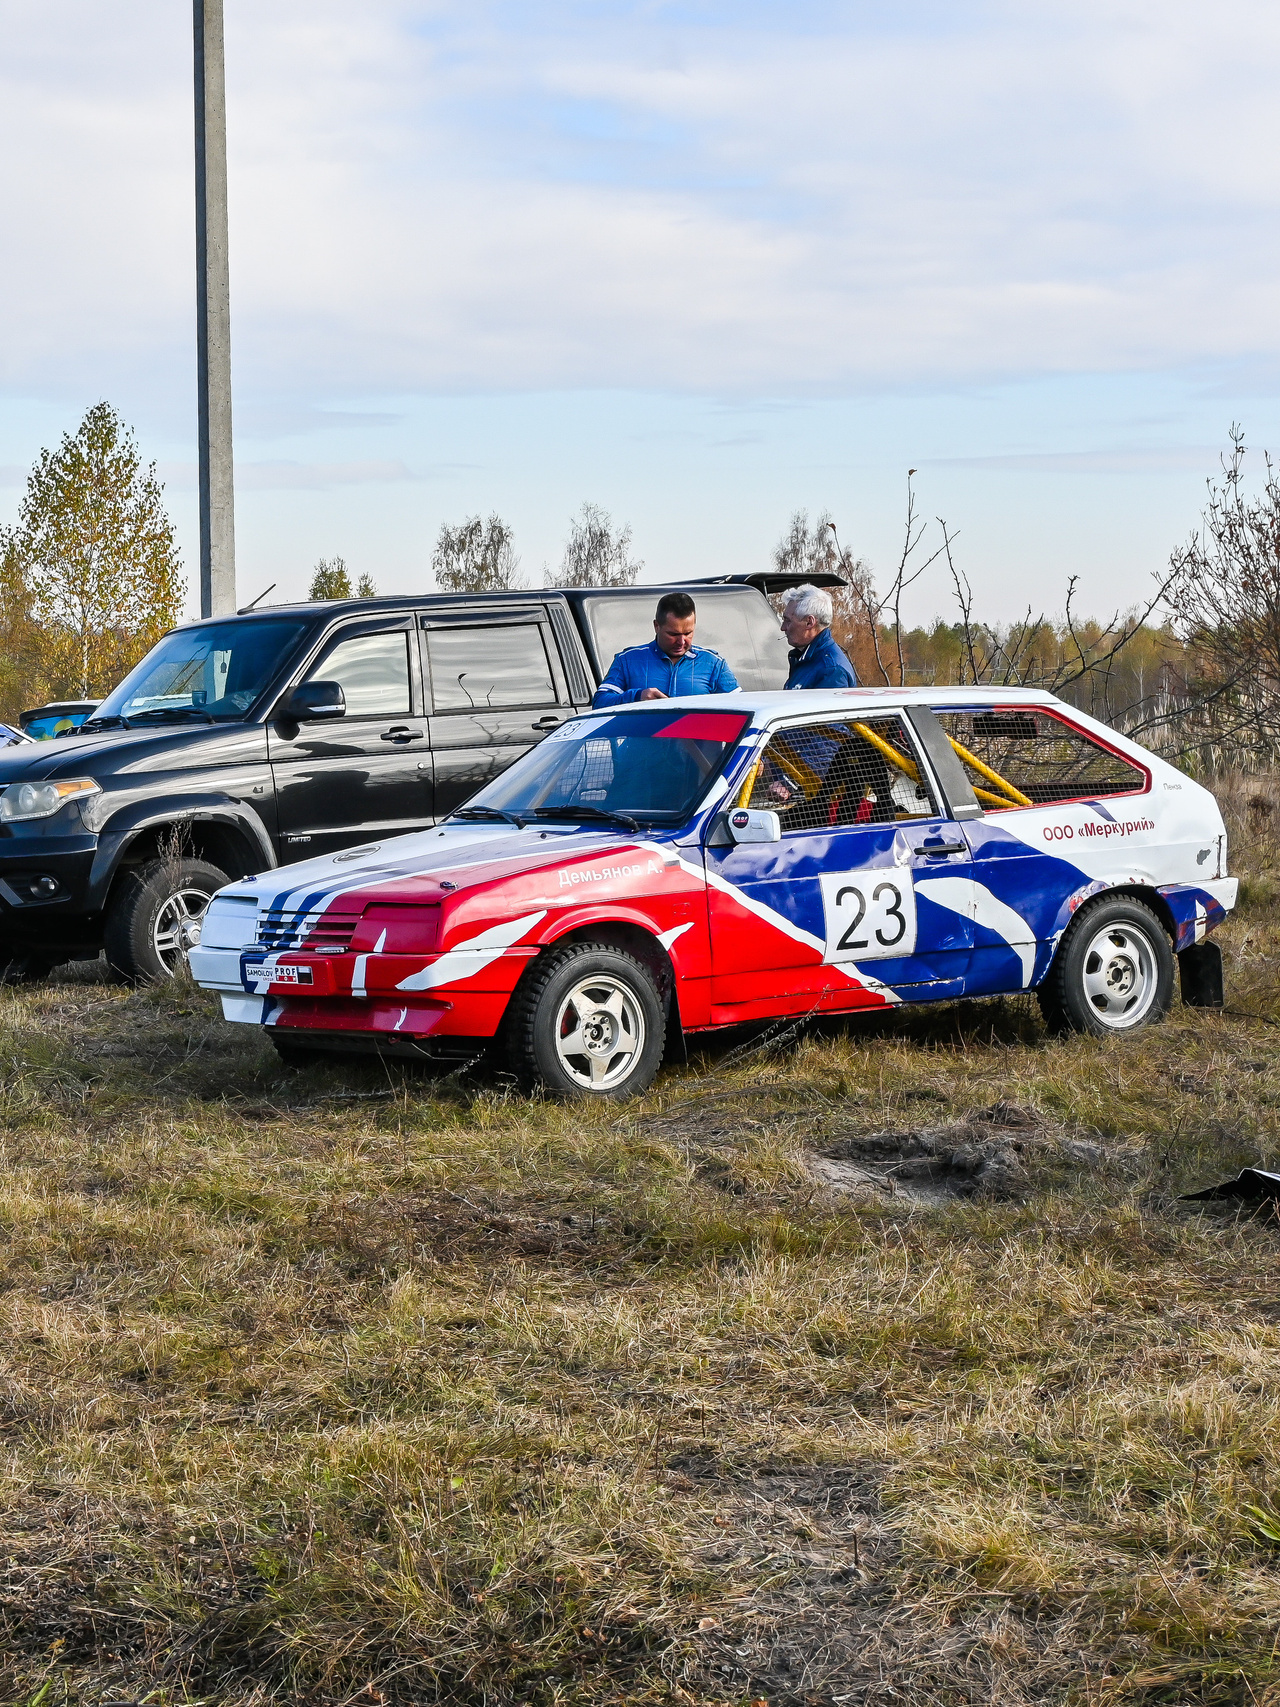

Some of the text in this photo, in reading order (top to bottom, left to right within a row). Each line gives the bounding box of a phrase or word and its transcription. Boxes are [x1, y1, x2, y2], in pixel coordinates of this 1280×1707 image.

[553, 722, 581, 738] 23
[1043, 817, 1155, 841] ООО «Меркурий»
[558, 864, 641, 888] Демьянов
[835, 882, 907, 951] 23
[274, 967, 296, 976] PROF
